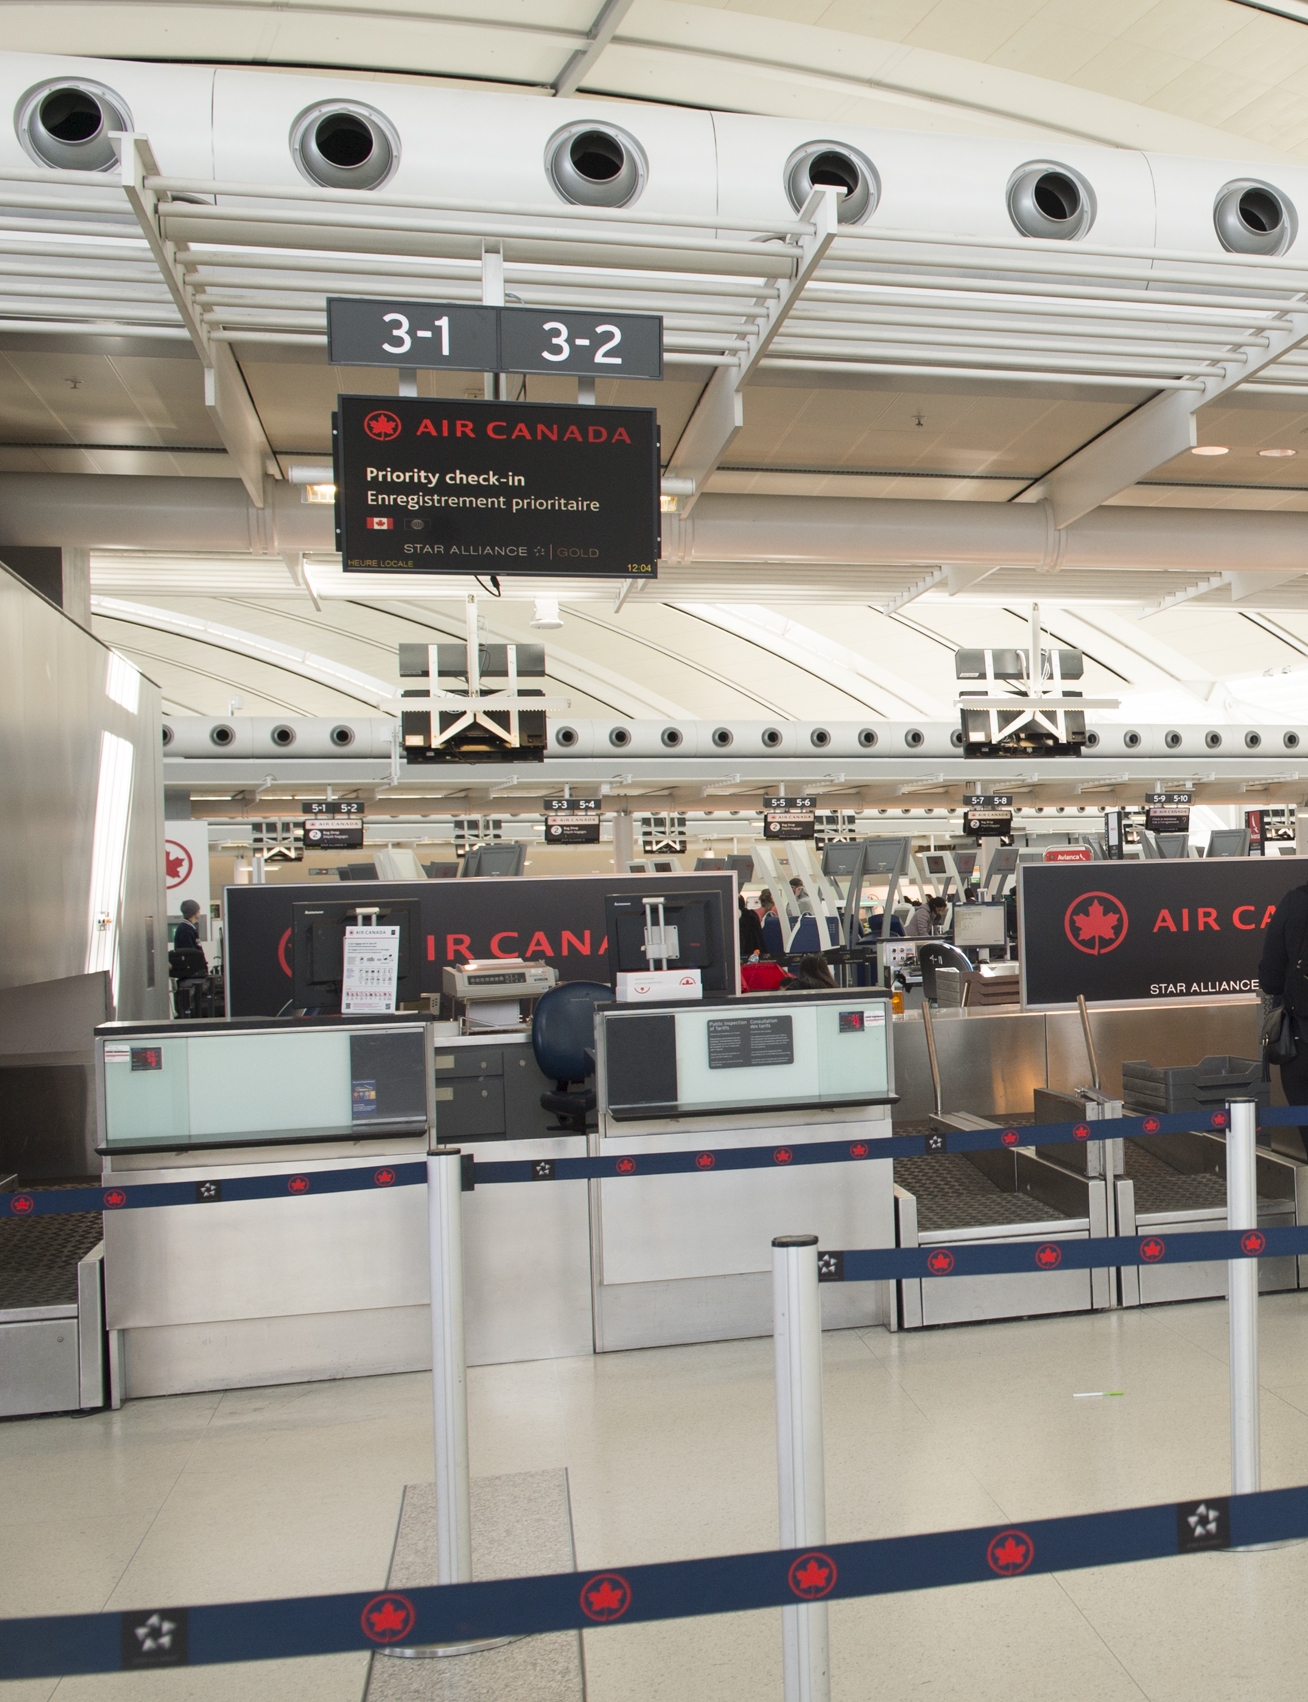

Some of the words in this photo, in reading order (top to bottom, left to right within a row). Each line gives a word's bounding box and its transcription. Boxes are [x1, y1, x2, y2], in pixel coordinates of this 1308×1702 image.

[382, 313, 449, 355] 3-1
[541, 321, 622, 364] 3-2
[416, 418, 476, 438] AIR
[487, 421, 632, 444] CANADA
[366, 467, 440, 487] Priority
[445, 470, 525, 487] check-in
[367, 490, 507, 510] Enregistrement
[512, 496, 600, 513] prioritaire
[403, 544, 446, 555] STAR
[449, 544, 528, 557] ALLIANCE
[557, 547, 599, 558] GOLD
[348, 559, 378, 567] HEURE
[380, 560, 414, 568] LOCALE
[627, 563, 652, 572] 12:04
[552, 800, 568, 809] 5-3
[579, 800, 595, 809] 5-4
[771, 799, 786, 807] 5-5
[796, 799, 811, 807] 5-6
[971, 796, 984, 805] 5-7
[994, 797, 1007, 805] 5-8
[312, 804, 326, 812] 5-1
[341, 804, 358, 812] 5-2
[1153, 907, 1221, 933] AIR
[427, 933, 475, 960] IR
[490, 930, 608, 959] CAN
[1150, 982, 1186, 995] STAR
[1190, 979, 1259, 993] ALLIANCE
